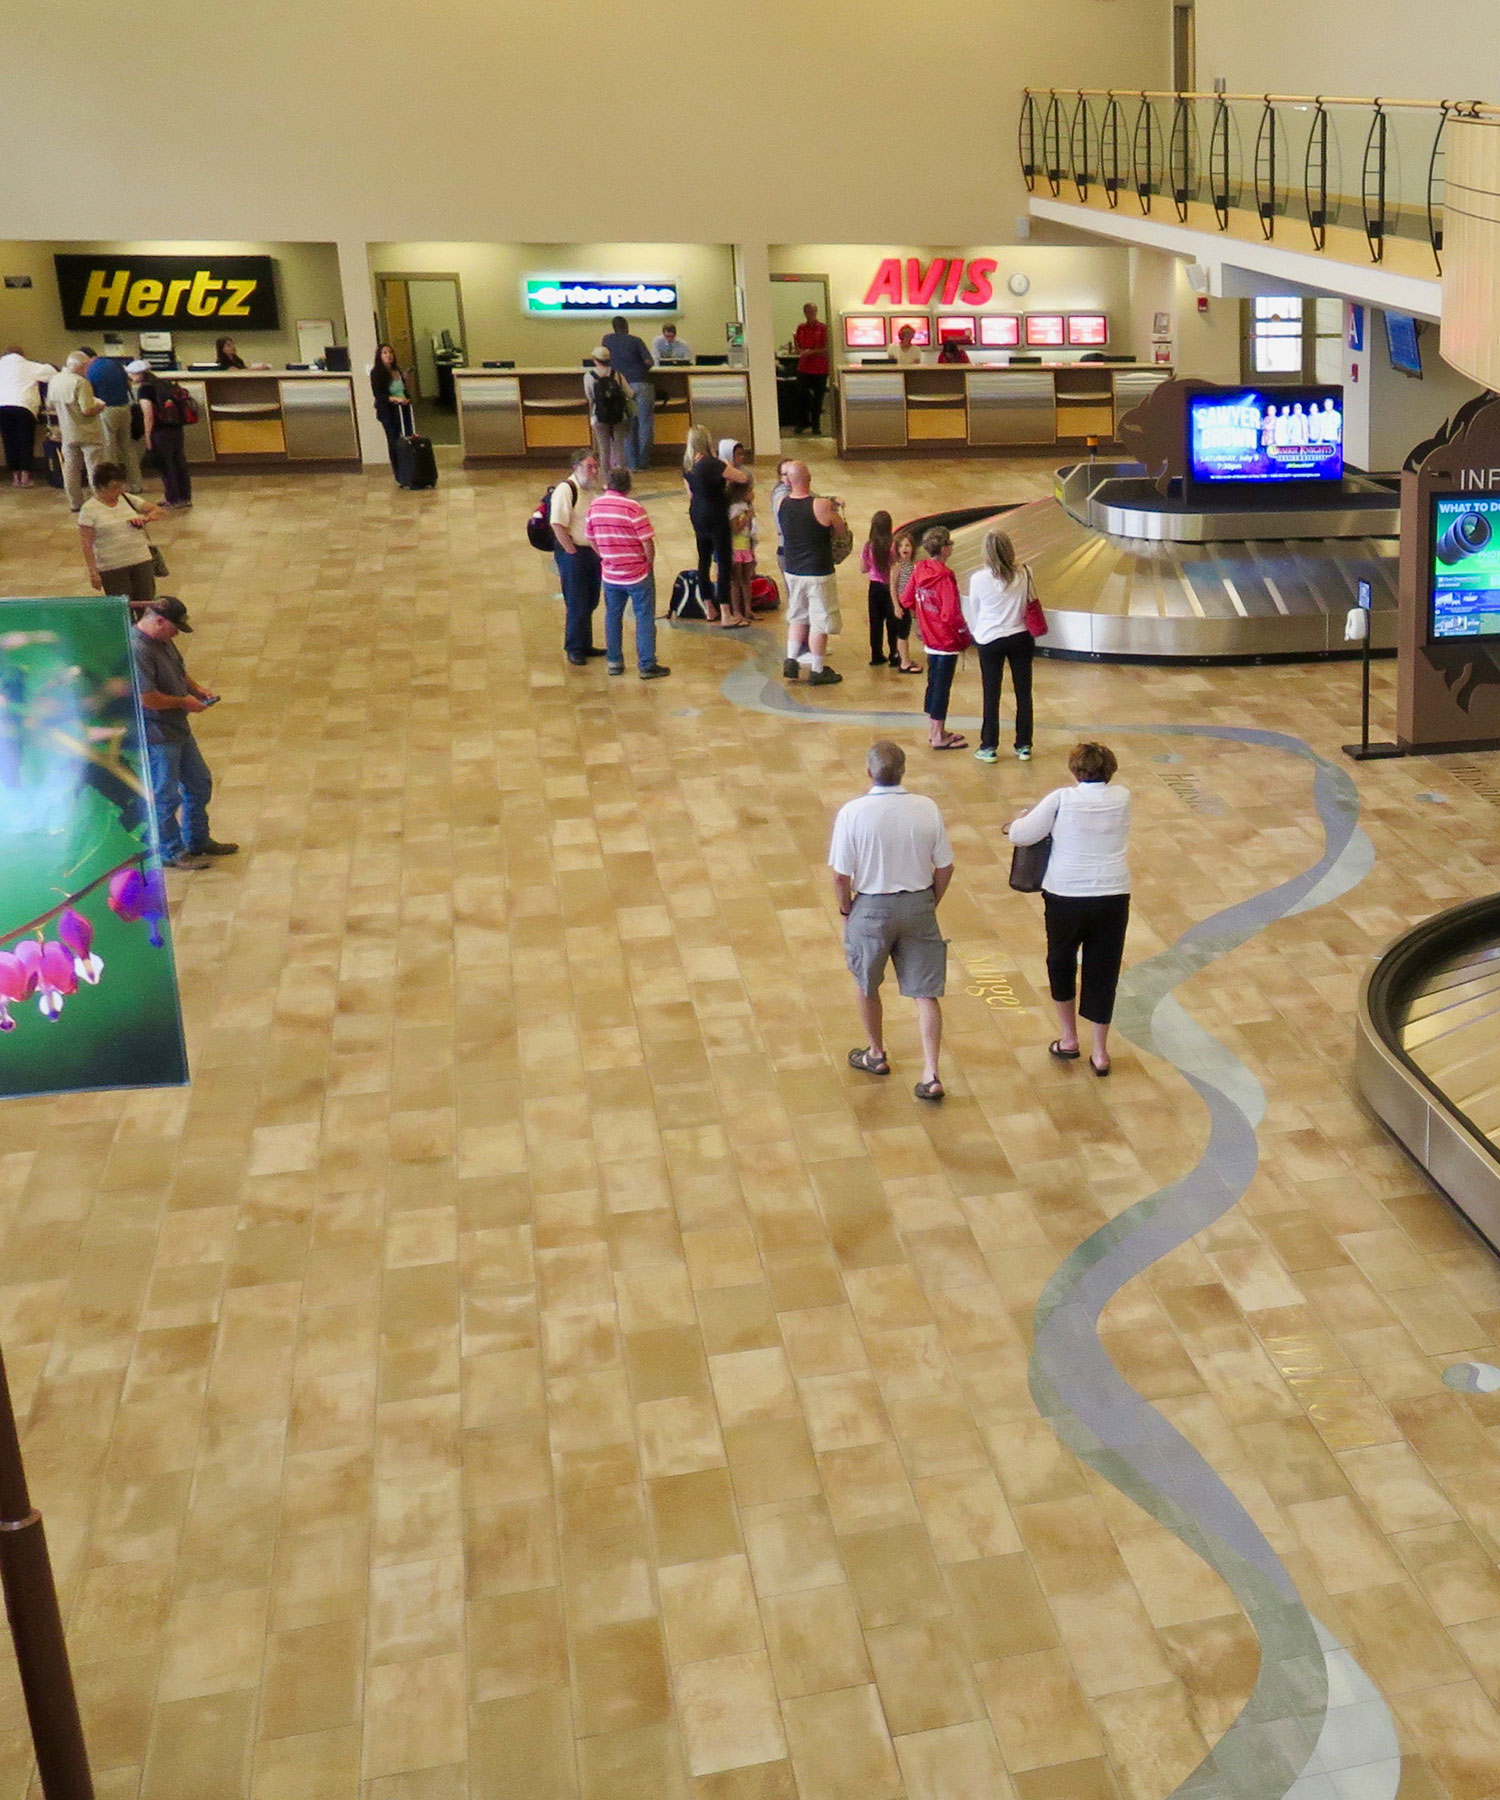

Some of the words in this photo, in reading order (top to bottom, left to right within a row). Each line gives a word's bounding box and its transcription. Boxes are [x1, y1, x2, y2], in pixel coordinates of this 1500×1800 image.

[80, 270, 257, 317] Hertz
[863, 257, 998, 306] AVIS
[529, 284, 676, 308] enterprise
[1198, 406, 1261, 430] SAWYER
[1201, 427, 1258, 450] BROWN
[1439, 503, 1472, 513] WHAT
[1473, 502, 1488, 512] TO
